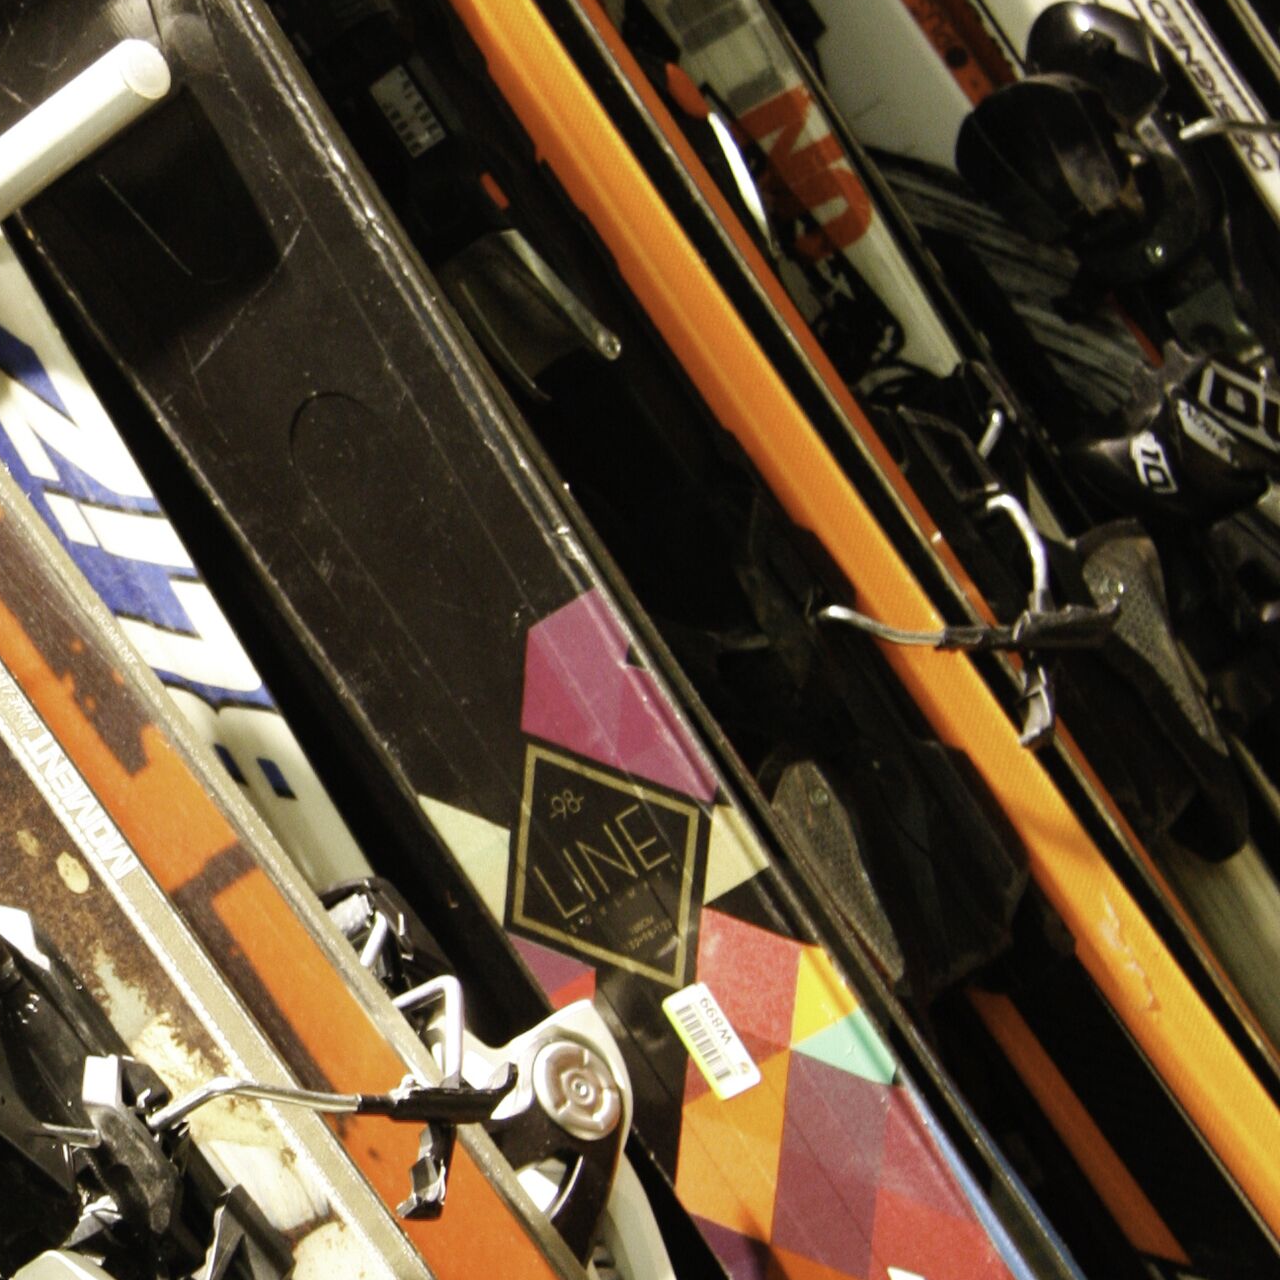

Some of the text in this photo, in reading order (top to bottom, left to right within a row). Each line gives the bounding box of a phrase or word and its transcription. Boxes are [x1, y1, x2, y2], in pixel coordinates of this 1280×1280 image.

[20, 725, 140, 879] MOMENT
[532, 803, 671, 919] LINE
[698, 995, 734, 1045] W899
